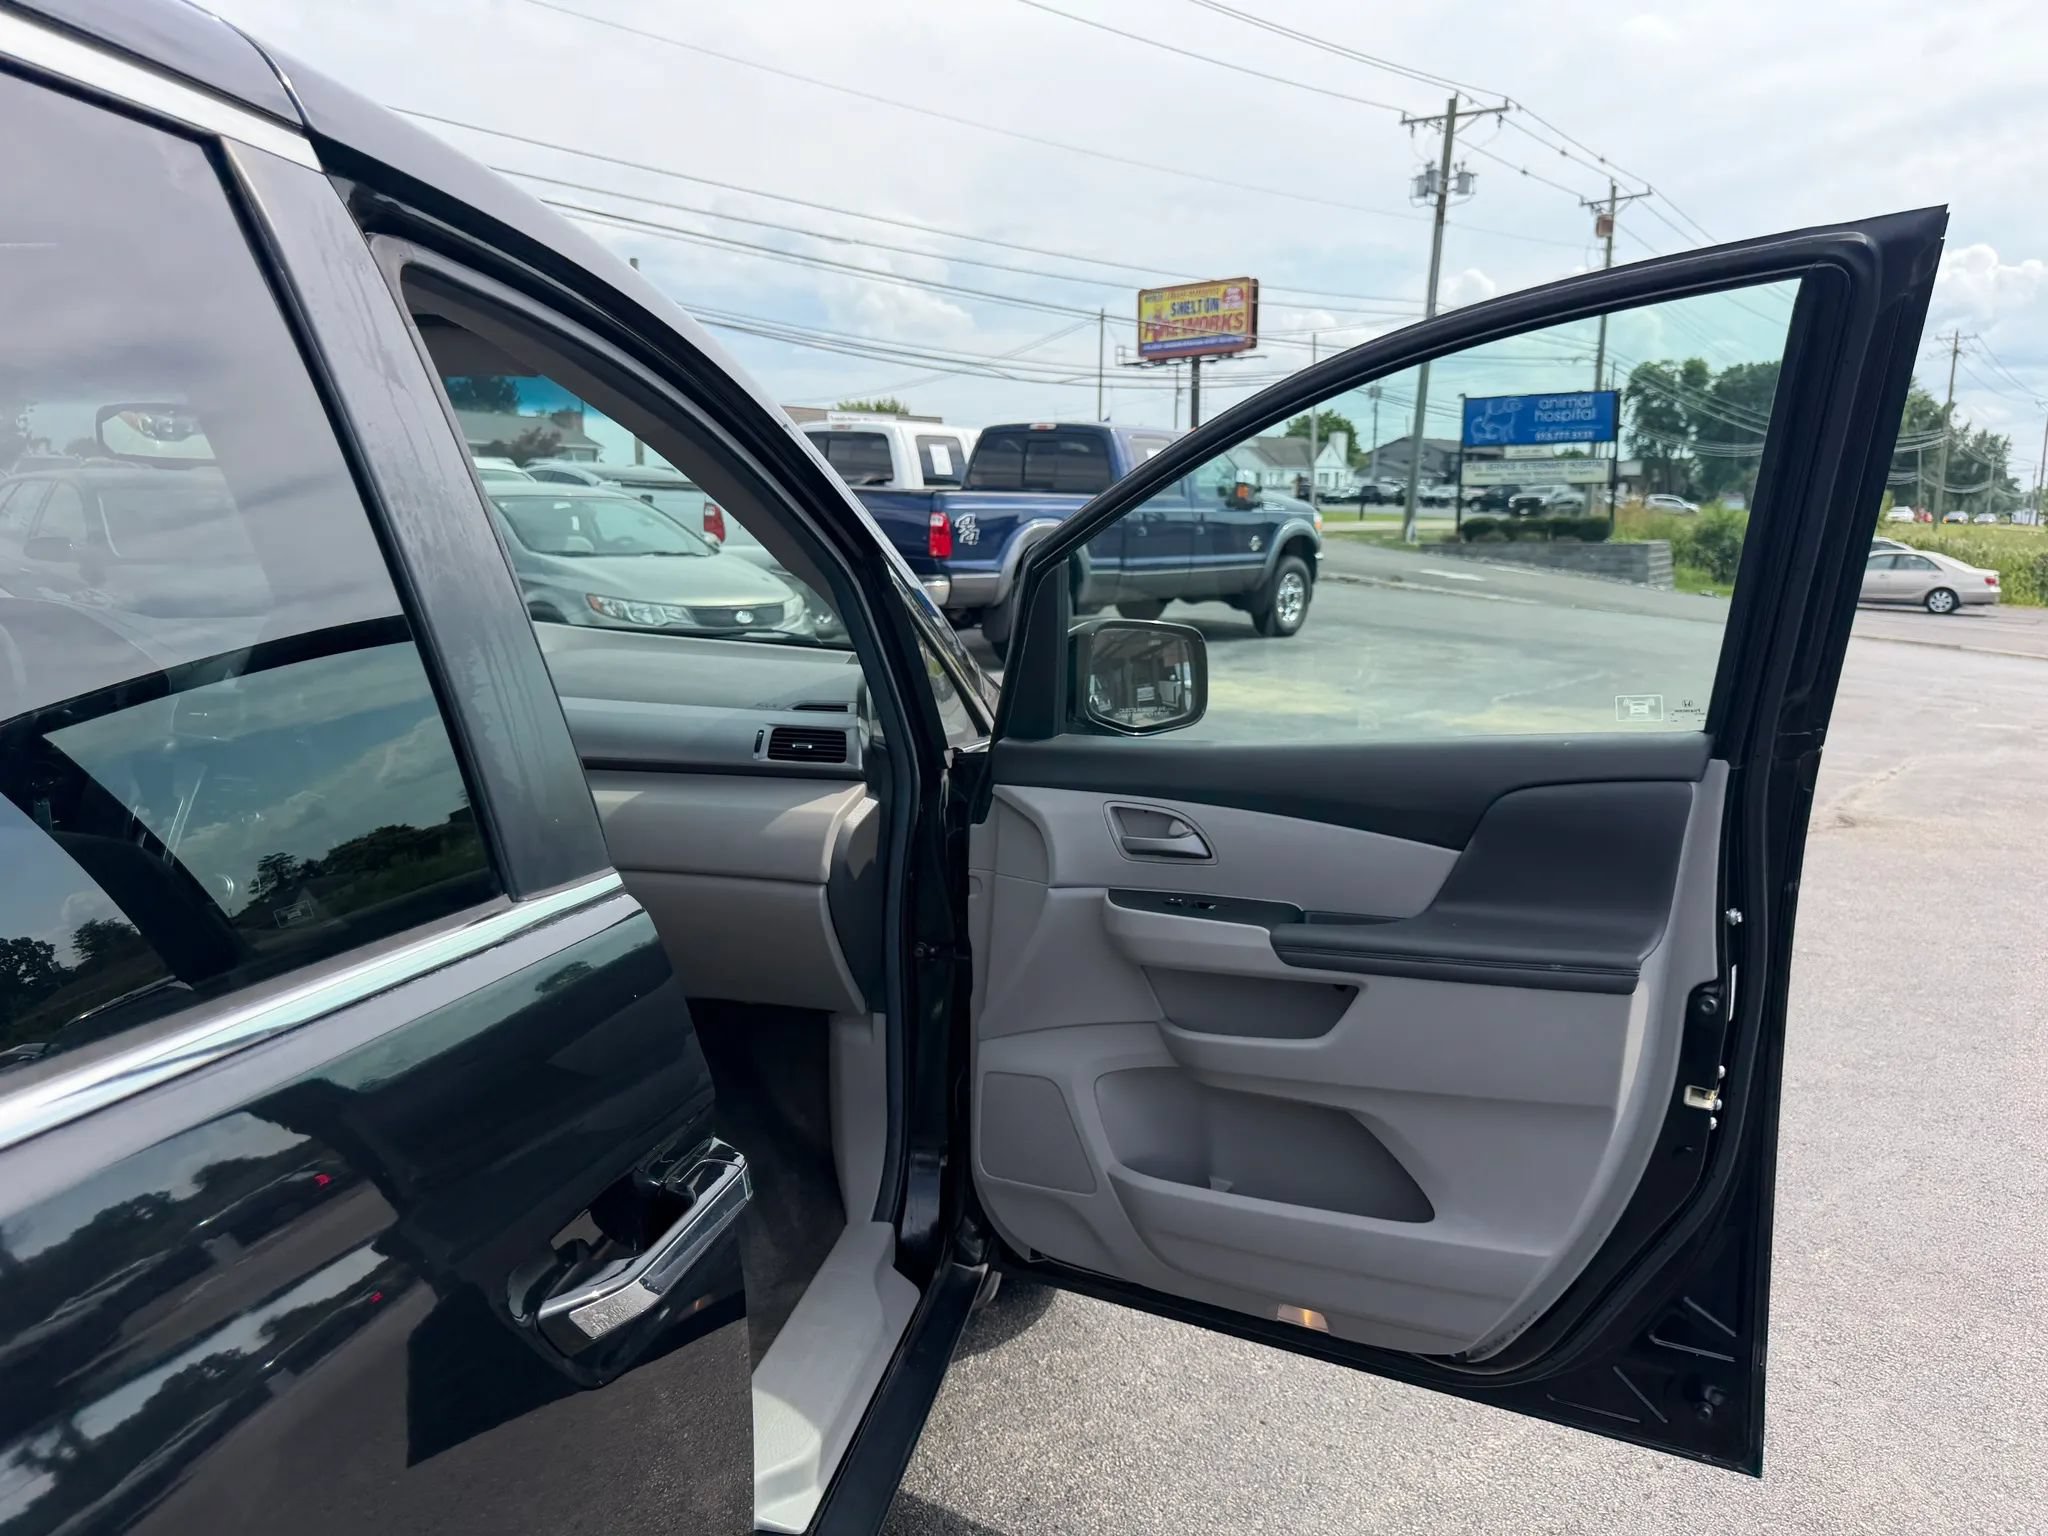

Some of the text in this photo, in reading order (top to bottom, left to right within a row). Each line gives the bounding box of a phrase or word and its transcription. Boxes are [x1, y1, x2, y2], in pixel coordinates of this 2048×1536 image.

[1171, 297, 1219, 317] SHELTON
[1538, 395, 1593, 410] animal
[1534, 408, 1596, 423] hospital
